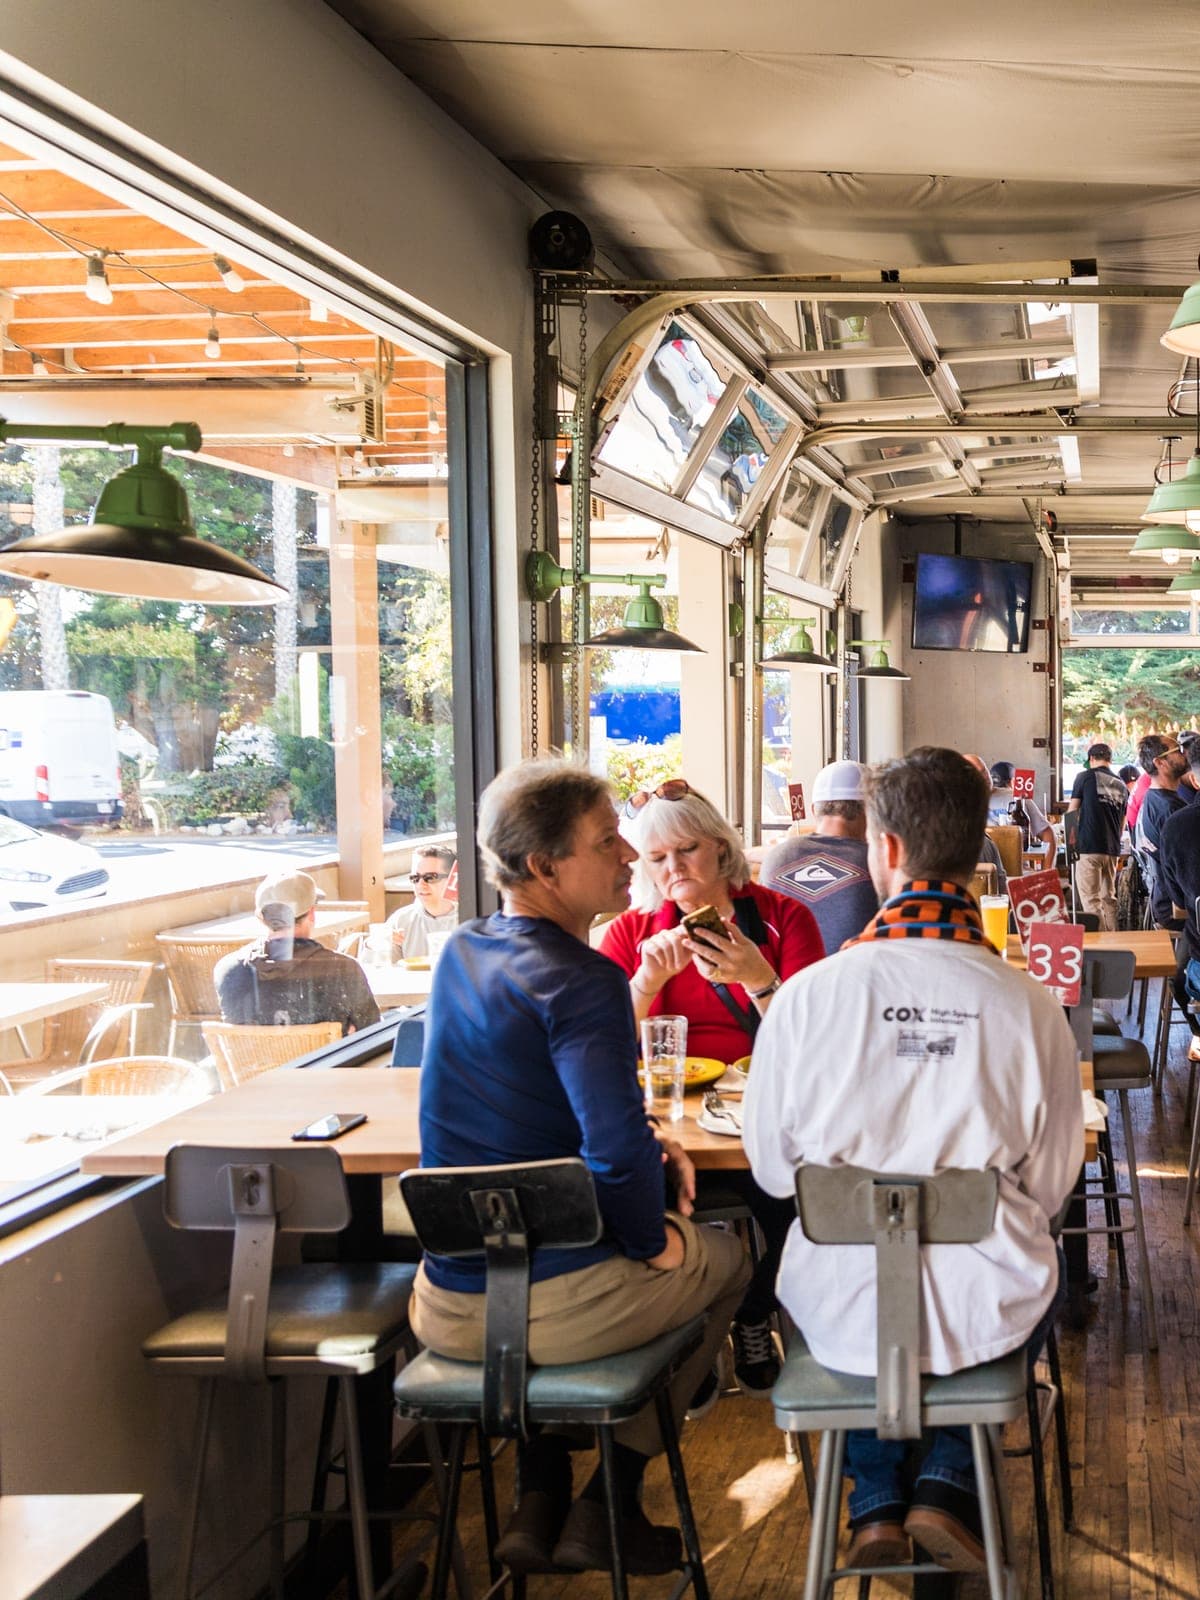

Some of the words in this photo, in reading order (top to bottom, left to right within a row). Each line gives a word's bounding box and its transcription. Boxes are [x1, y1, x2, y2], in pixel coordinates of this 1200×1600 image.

[1015, 776, 1033, 791] 36
[791, 795, 803, 811] 90
[1028, 944, 1081, 984] 33
[883, 1007, 925, 1022] COX
